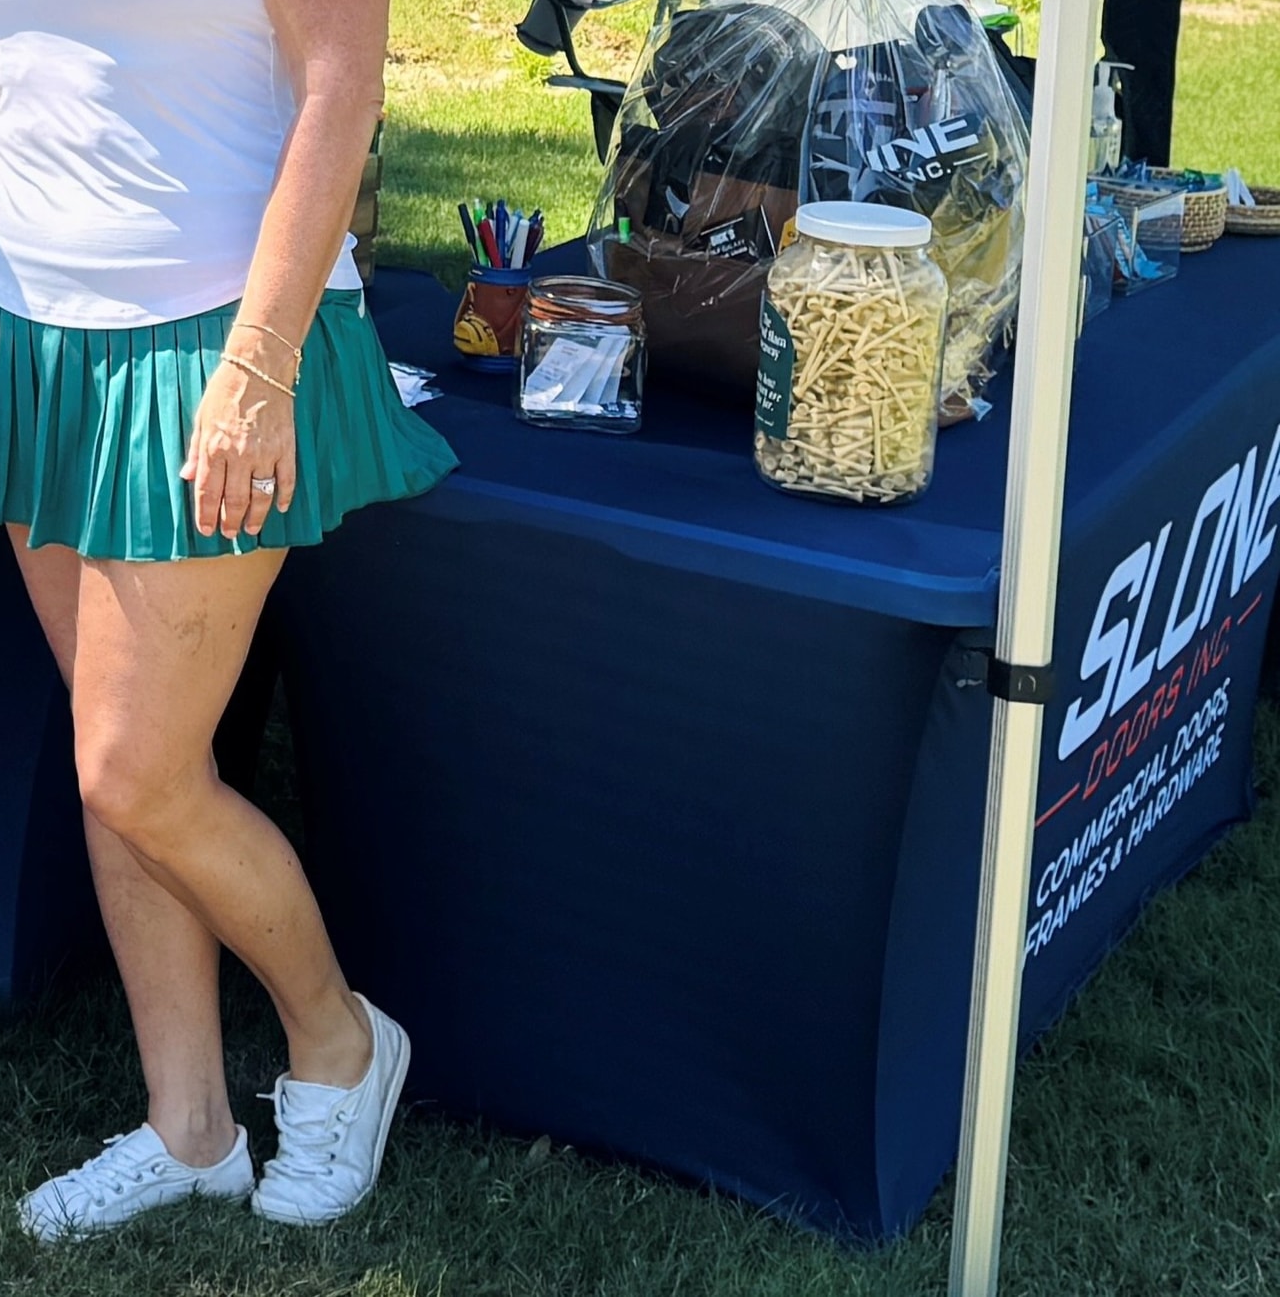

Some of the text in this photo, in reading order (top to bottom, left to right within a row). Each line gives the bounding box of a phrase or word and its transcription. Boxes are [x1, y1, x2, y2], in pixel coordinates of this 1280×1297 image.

[1036, 677, 1231, 908] COMMERCIAL DOORS,
[1082, 616, 1232, 800] DOORS INC.
[1022, 723, 1225, 963] FRAMES & HARDWARE
